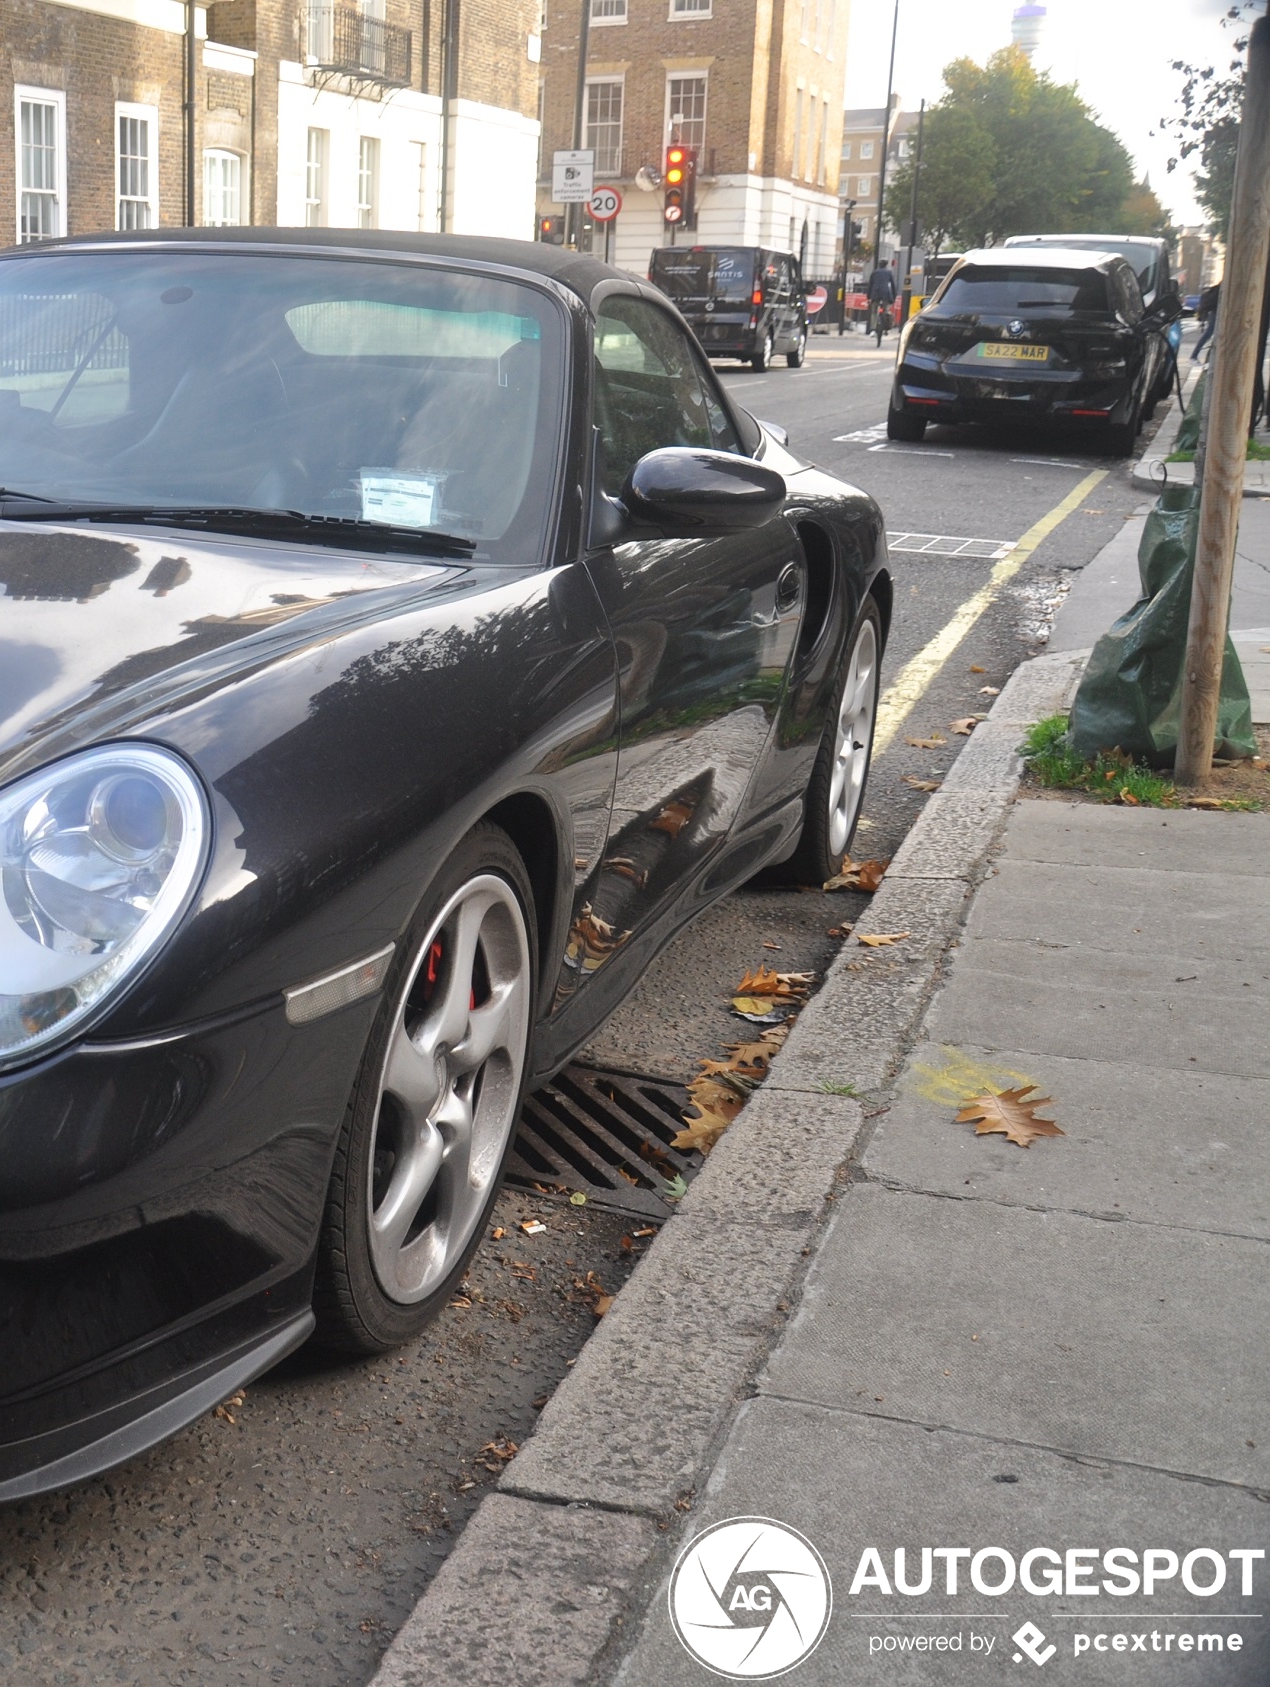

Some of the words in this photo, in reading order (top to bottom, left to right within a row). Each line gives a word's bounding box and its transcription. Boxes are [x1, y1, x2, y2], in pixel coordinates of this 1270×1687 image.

[593, 196, 616, 211] 20
[986, 344, 1019, 357] SA22
[1020, 346, 1046, 359] MAR
